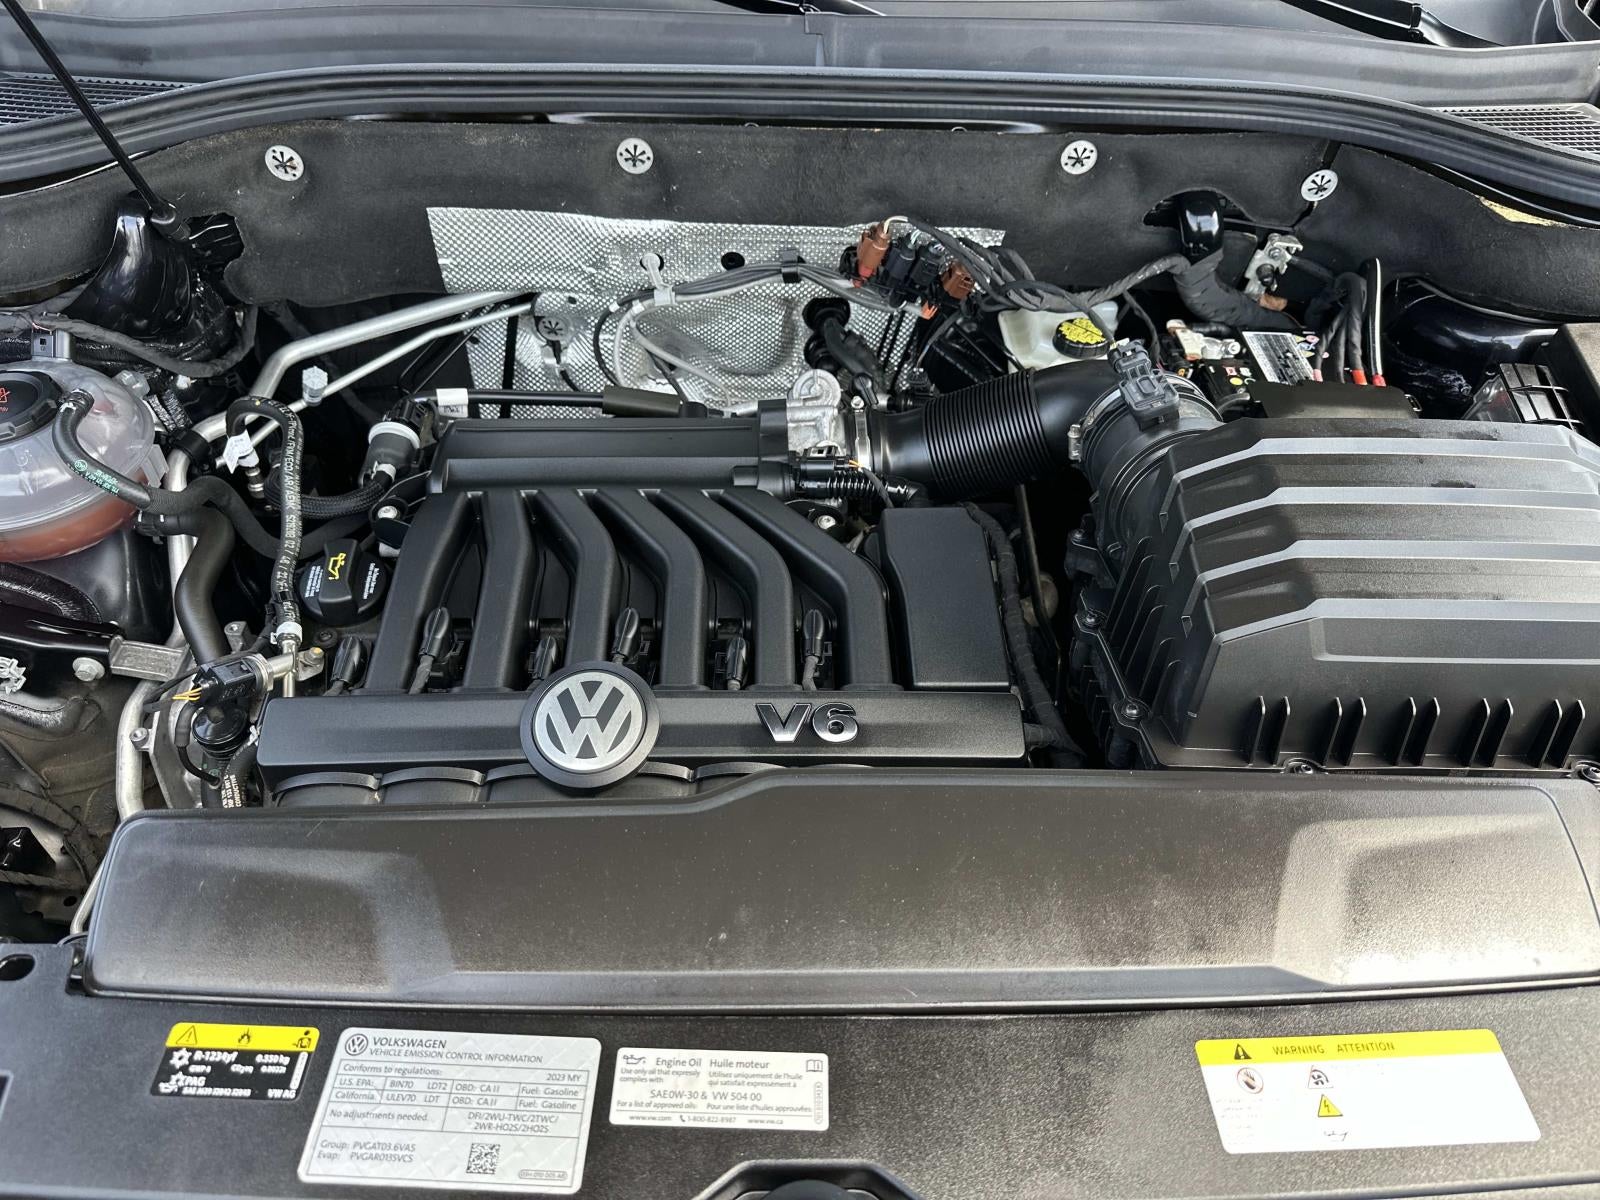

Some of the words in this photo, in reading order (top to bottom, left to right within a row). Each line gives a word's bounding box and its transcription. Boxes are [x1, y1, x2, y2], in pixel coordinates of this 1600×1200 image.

[756, 702, 859, 743] V6
[373, 1036, 447, 1049] VOLKSWAGEN
[1272, 1043, 1325, 1056] WARNING
[1336, 1041, 1396, 1054] ATTENTION
[369, 1048, 402, 1057] VEHICLE
[403, 1049, 444, 1059] EMISSION
[445, 1051, 482, 1061] CONTROL
[485, 1053, 543, 1063] INFORMATION
[656, 1057, 687, 1068] Engine
[688, 1058, 702, 1067] Oil
[736, 1060, 770, 1069] moteur
[343, 1063, 382, 1073] Conforms
[384, 1065, 392, 1073] to
[394, 1066, 442, 1076] regulations:
[634, 1068, 647, 1076] only
[546, 1073, 566, 1082] 2023
[567, 1074, 581, 1082] MY
[619, 1076, 648, 1084] complies
[733, 1072, 773, 1081] uniquement
[339, 1078, 354, 1086] U.S.
[356, 1078, 374, 1087] EPA:
[390, 1080, 414, 1089] BIN70
[427, 1082, 448, 1091] LDT2
[455, 1083, 476, 1092] OBD:
[282, 1089, 297, 1099] AG
[543, 1087, 579, 1097] Gasoline
[700, 1091, 708, 1100] &
[712, 1091, 729, 1101] VW
[730, 1092, 748, 1101] 504
[749, 1092, 763, 1102] 00
[386, 1092, 416, 1102] ULEV70
[424, 1094, 440, 1103] LDT
[452, 1096, 473, 1105] OBD:
[541, 1100, 577, 1110] Gasoline
[616, 1099, 628, 1107] For
[653, 1102, 684, 1110] approved
[735, 1103, 749, 1111] liste
[329, 1109, 342, 1118] No
[343, 1110, 395, 1120] adjustments
[320, 1139, 350, 1150] Group:
[317, 1151, 341, 1161] Evap:
